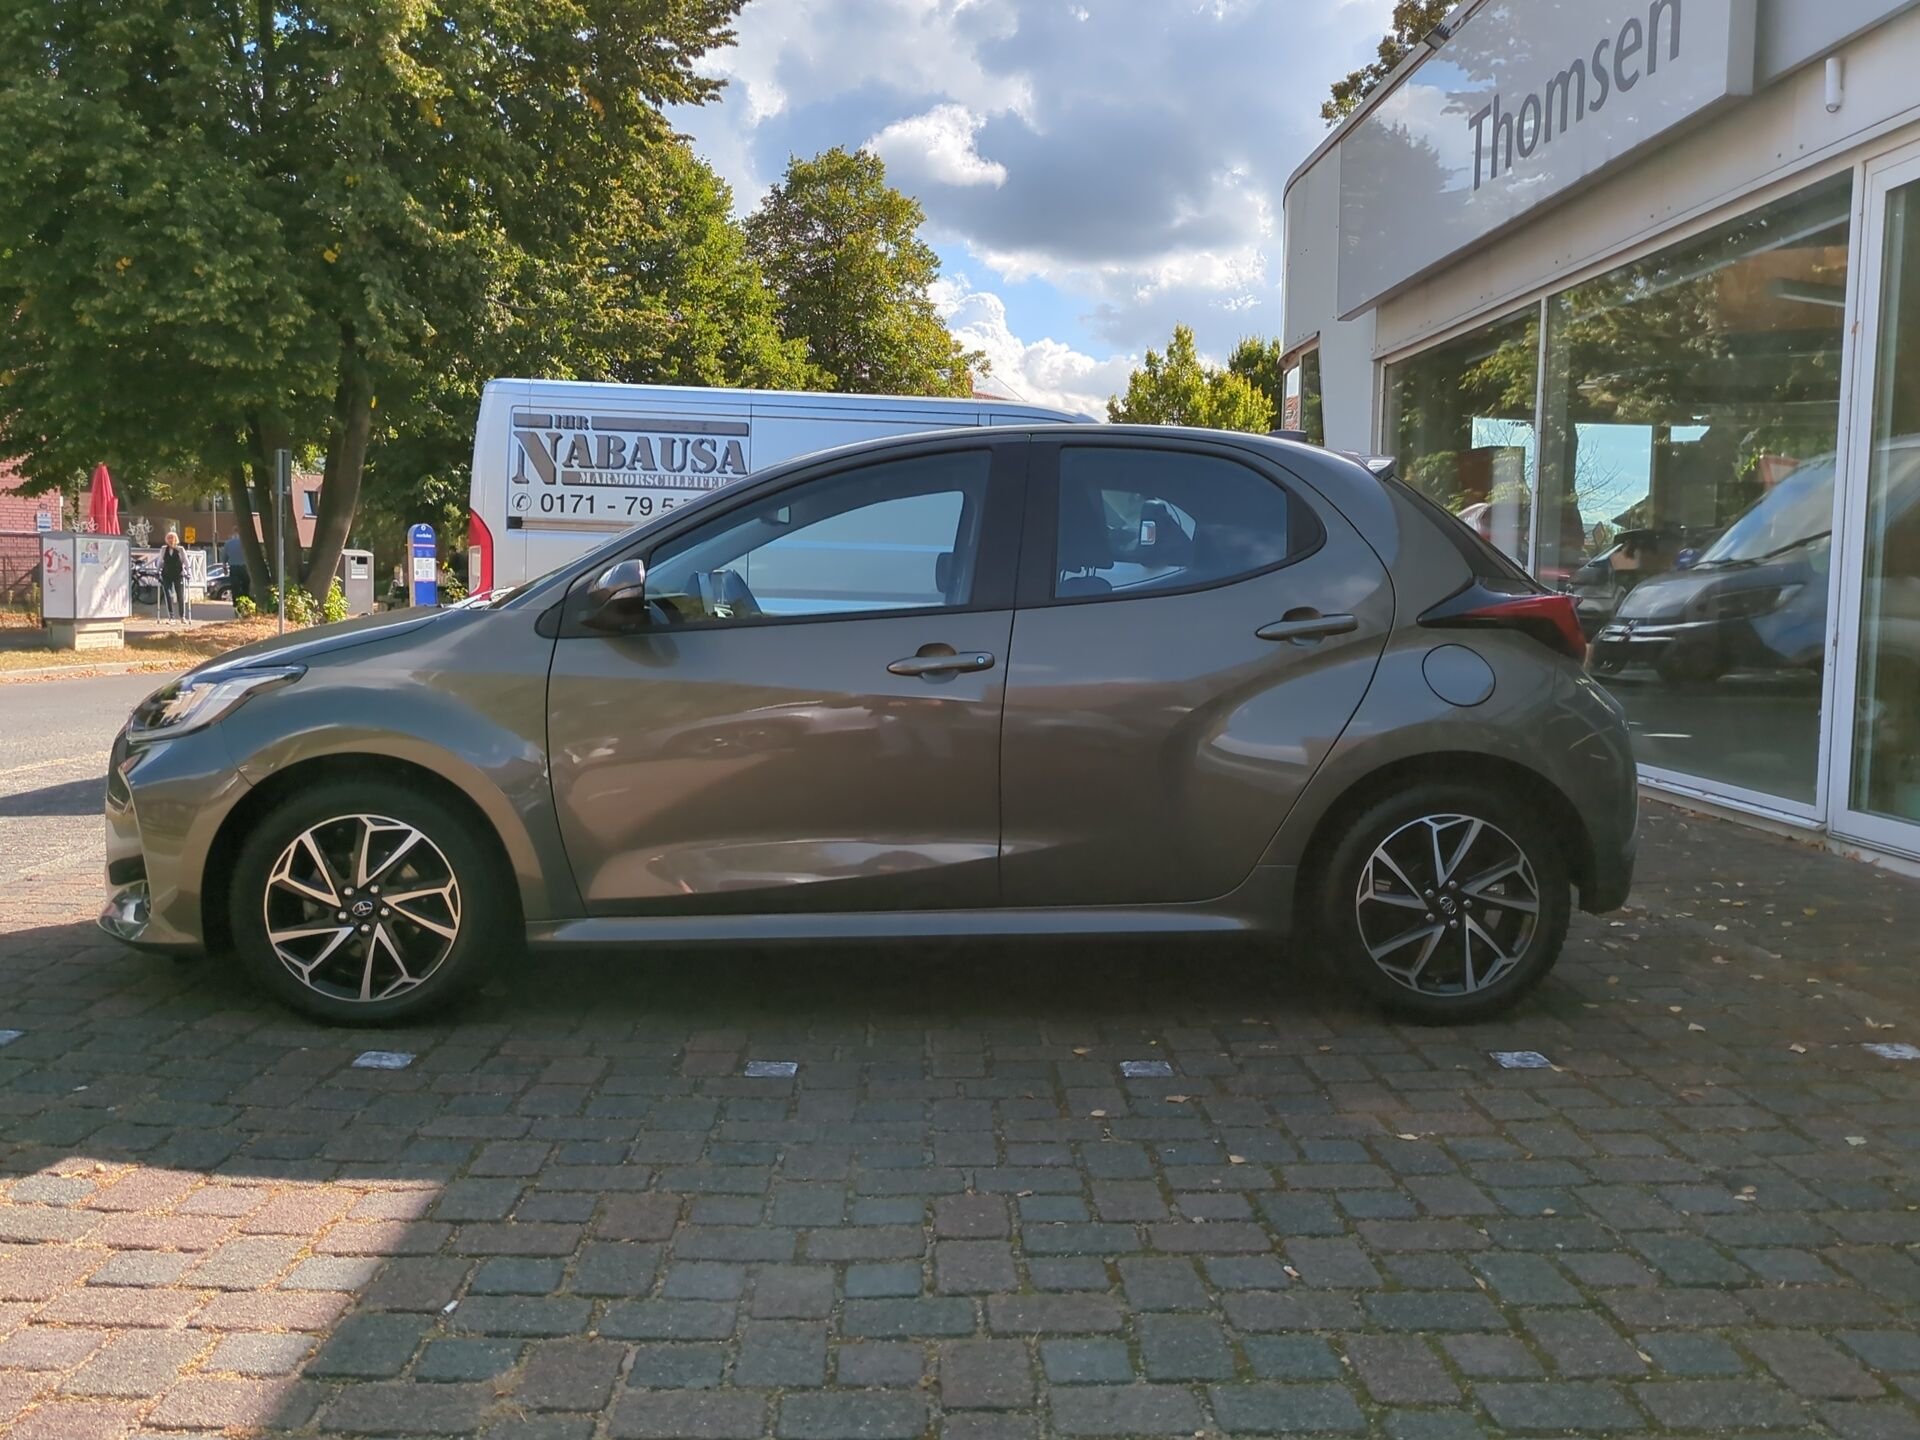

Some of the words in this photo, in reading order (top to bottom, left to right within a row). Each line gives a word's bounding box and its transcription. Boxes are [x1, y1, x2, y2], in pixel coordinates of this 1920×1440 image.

[1468, 0, 1681, 191] Thomsen
[554, 414, 590, 431] IHR
[512, 431, 748, 485] NABAUSA
[540, 493, 595, 514] 0171
[624, 496, 653, 516] 79
